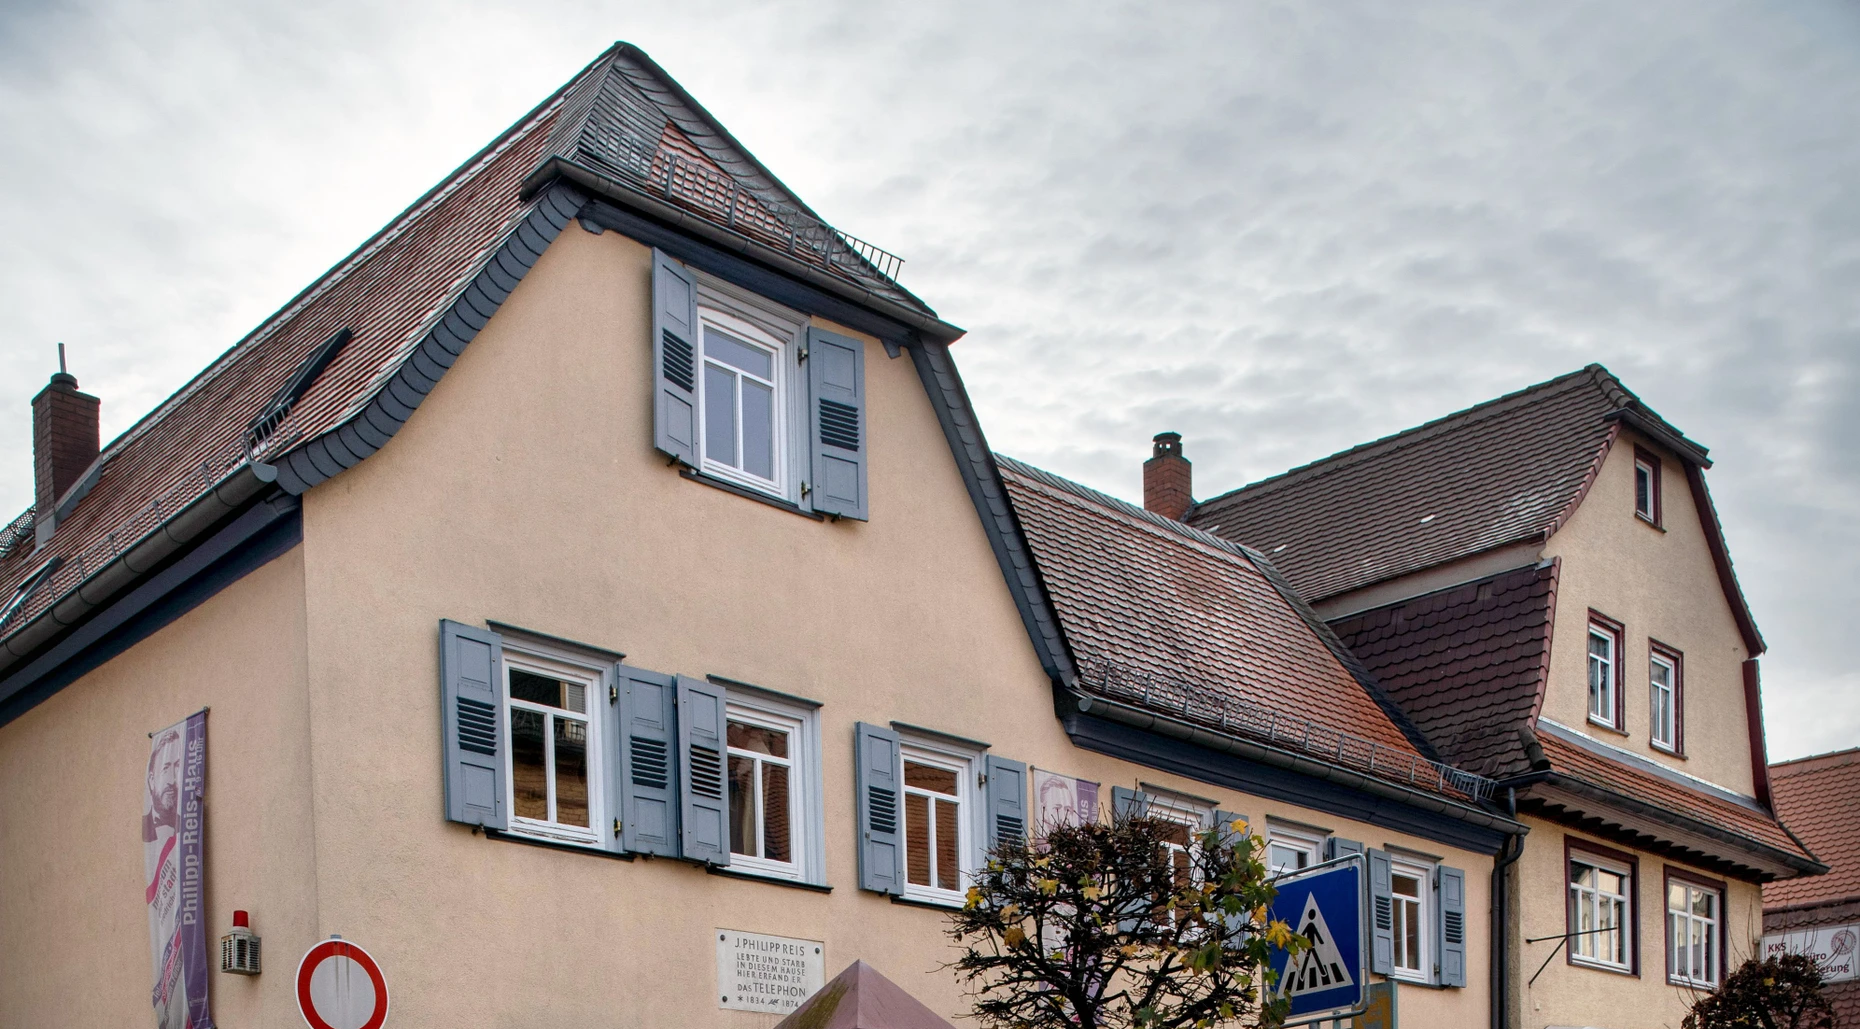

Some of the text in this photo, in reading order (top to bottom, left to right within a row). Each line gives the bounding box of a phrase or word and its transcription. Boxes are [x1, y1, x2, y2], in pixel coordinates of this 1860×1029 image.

[183, 739, 199, 925] Philipp-Reis-Haus
[743, 938, 780, 952] PHILIPP
[783, 944, 805, 956] REIS
[1768, 942, 1787, 953] KKS
[737, 953, 805, 968] LEBTE UND STARB
[737, 961, 805, 976] IN DIESEM HAUSE
[737, 970, 756, 978] HIER
[759, 972, 789, 982] ERFAND
[737, 982, 806, 997] DAS TELEPHON
[746, 996, 799, 1008] 1834 1874
